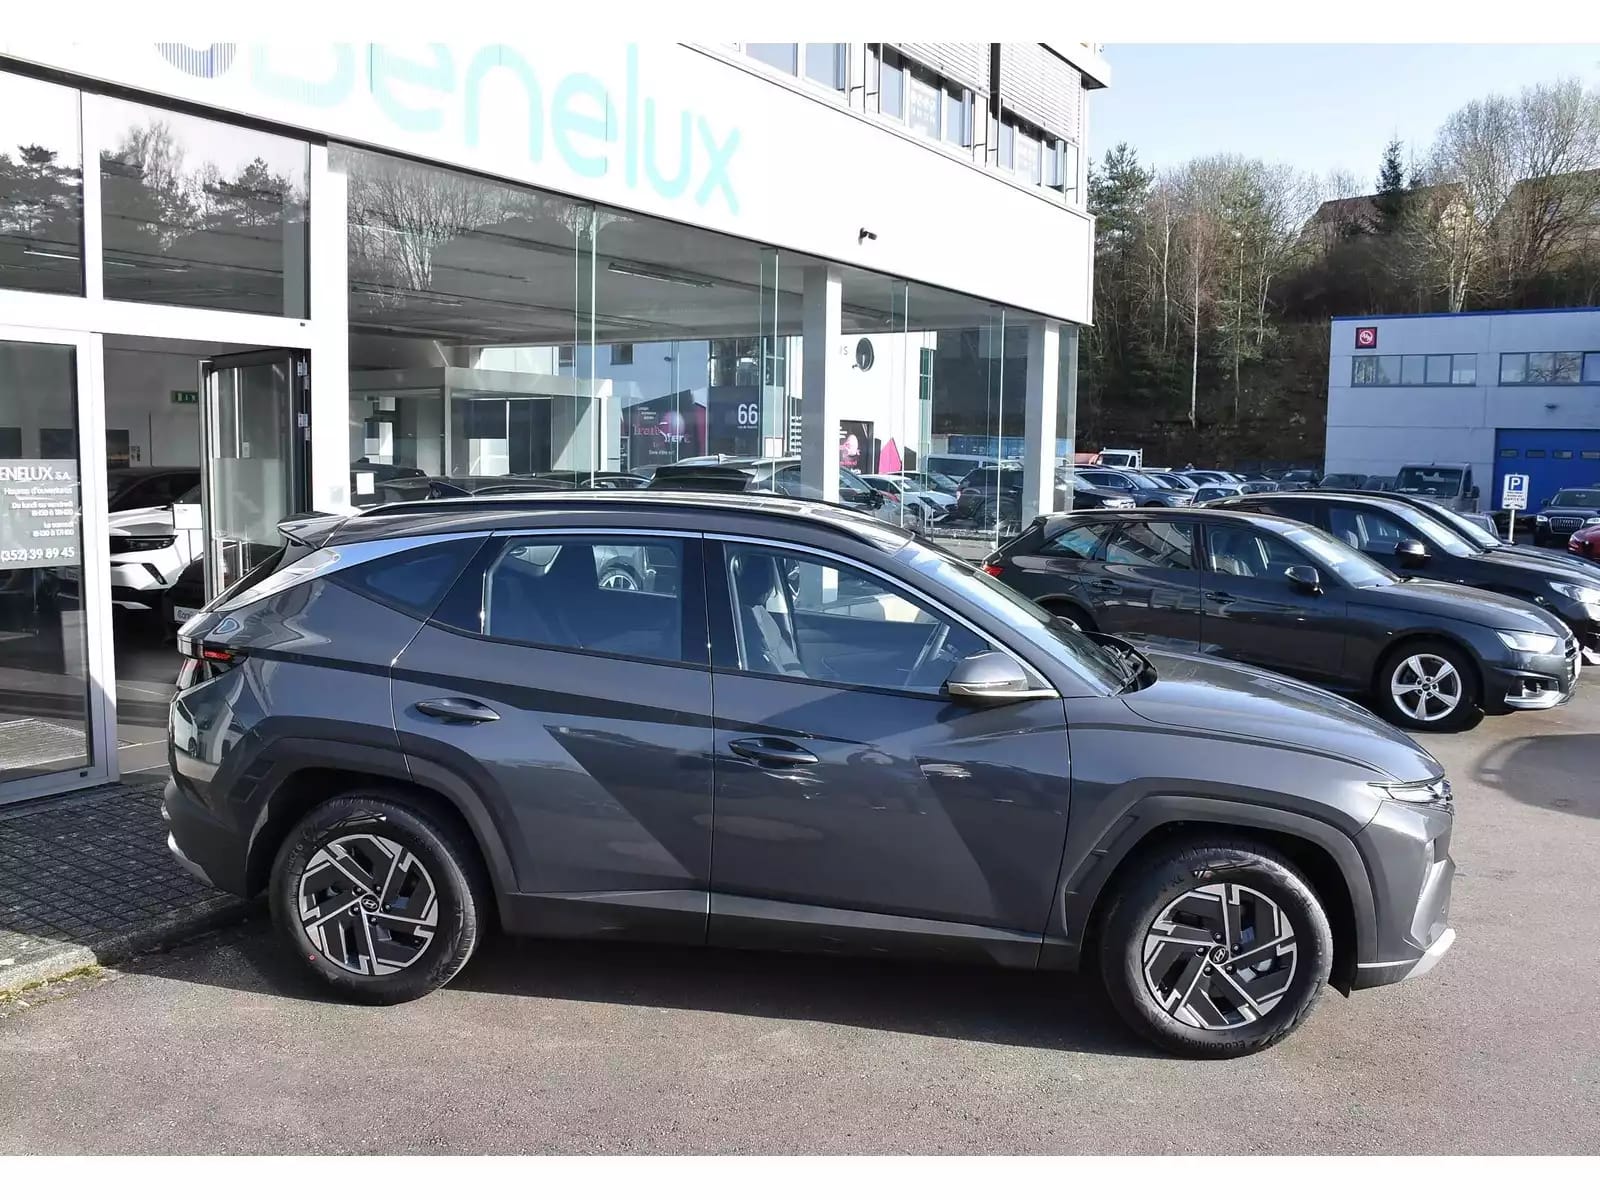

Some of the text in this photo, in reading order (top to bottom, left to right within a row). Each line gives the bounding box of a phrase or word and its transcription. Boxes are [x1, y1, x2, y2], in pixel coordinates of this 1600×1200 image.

[737, 403, 758, 425] 66
[1510, 477, 1521, 490] P
[1, 546, 75, 562] (352) 39 89 45
